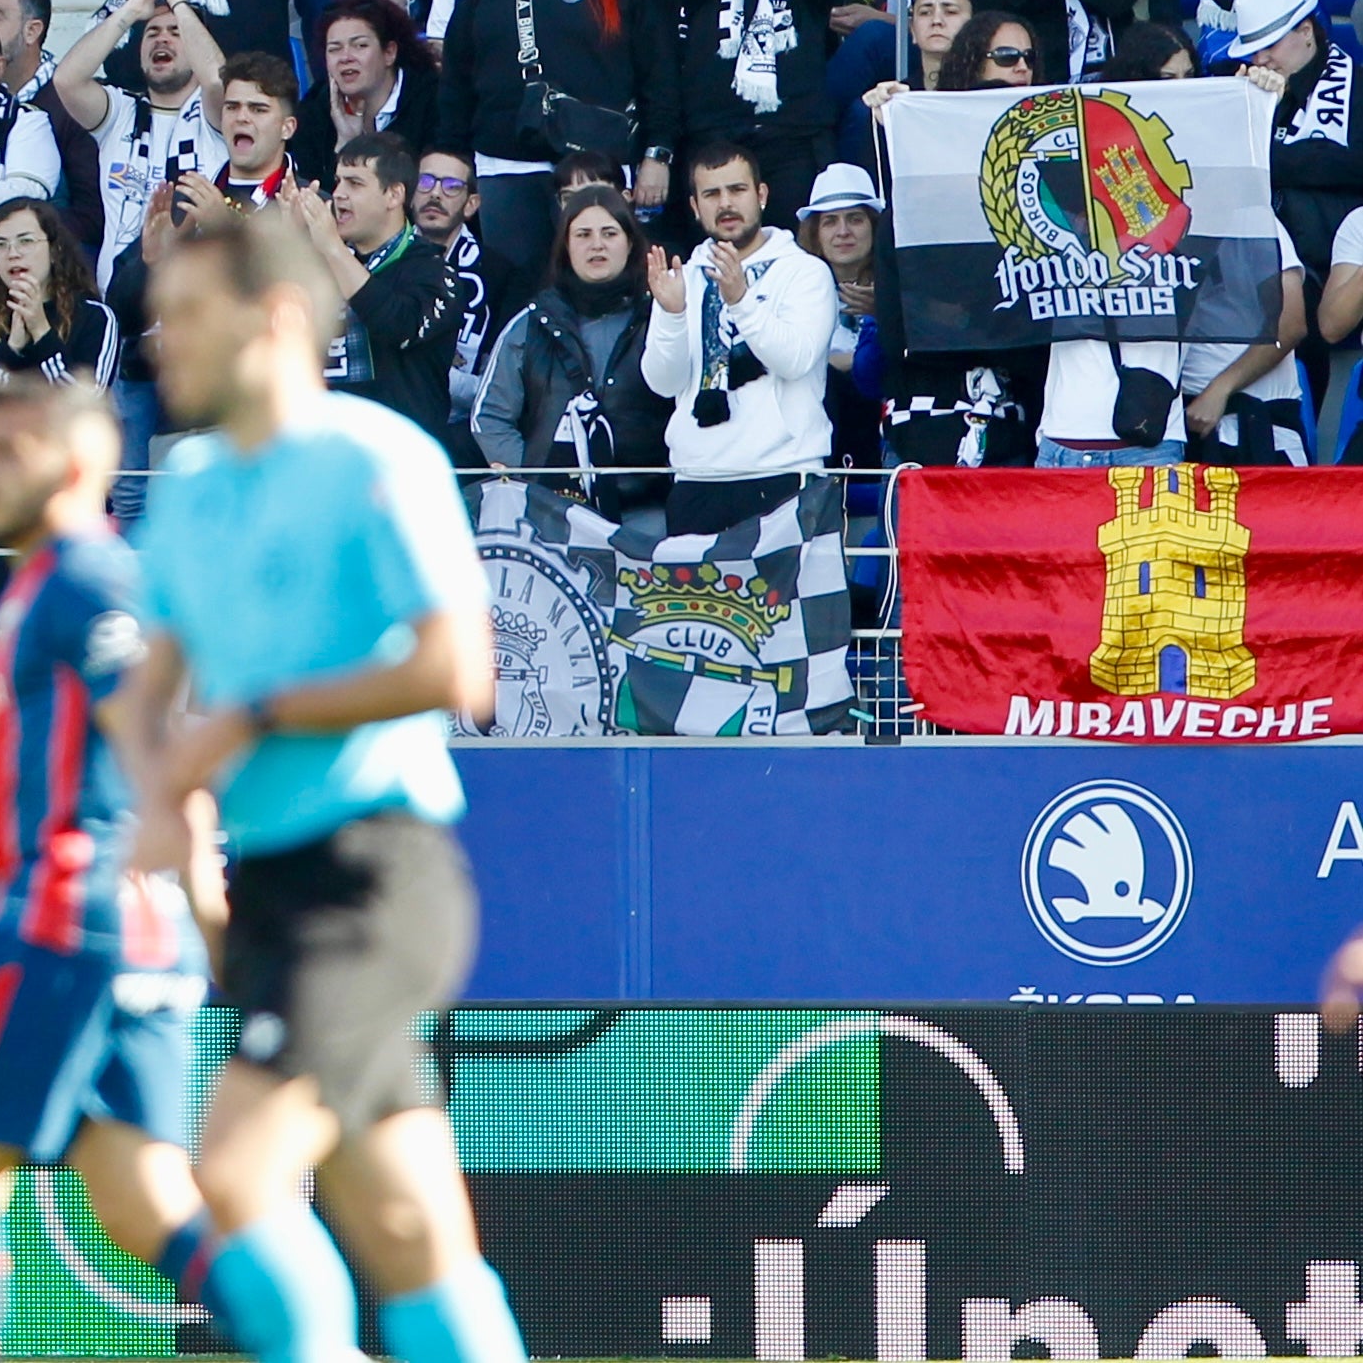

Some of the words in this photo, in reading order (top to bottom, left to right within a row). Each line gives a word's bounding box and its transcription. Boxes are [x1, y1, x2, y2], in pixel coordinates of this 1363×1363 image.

[1020, 171, 1059, 243] BURGOS
[1028, 288, 1176, 321] BURGOS
[665, 625, 733, 660] CLUB
